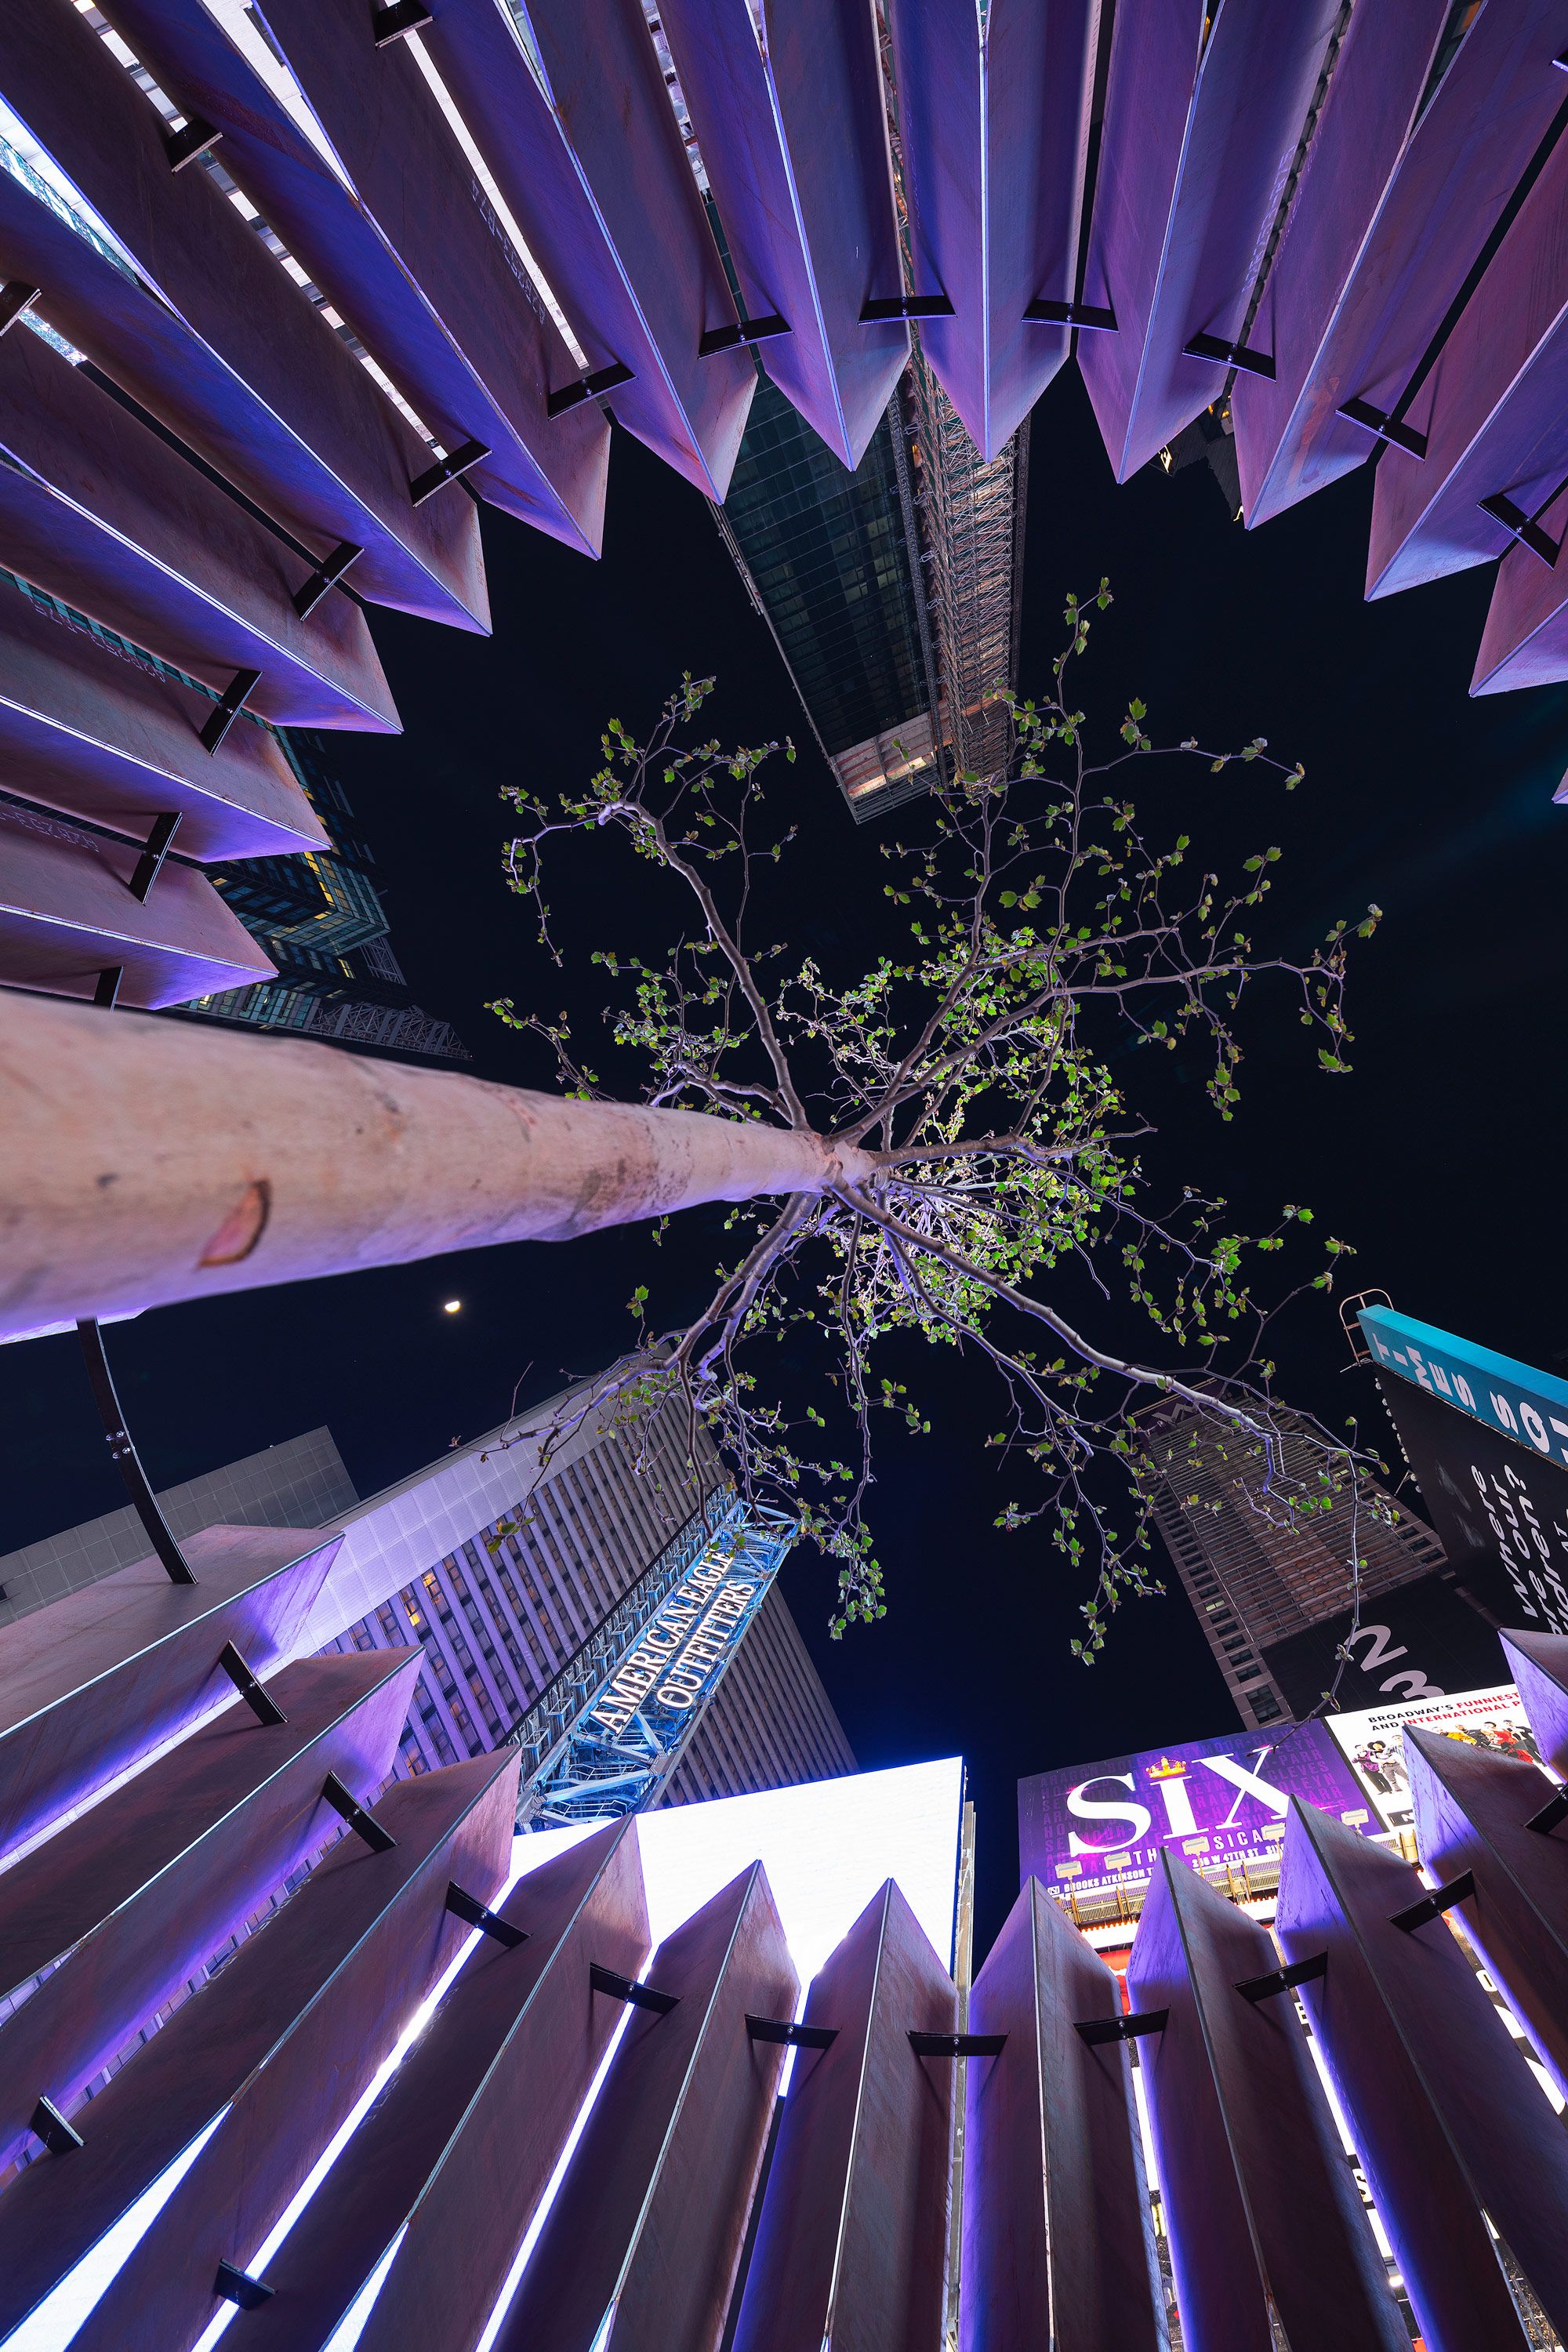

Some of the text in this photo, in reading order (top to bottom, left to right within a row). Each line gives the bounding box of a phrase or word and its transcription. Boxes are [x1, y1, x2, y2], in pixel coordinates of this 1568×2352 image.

[1372, 1332, 1477, 1412] TIMES
[1471, 1465, 1538, 1619] where
[1490, 1474, 1530, 1559] our
[589, 1548, 734, 1735] AMERICAN EAGLE
[656, 1579, 757, 1711] OUTFITTERS
[1368, 1692, 1520, 1723] BROADWAY'S FUNNIEST
[1372, 1704, 1510, 1731] AND INTERNATIONAL
[1067, 1744, 1291, 1858] SIX
[1064, 1878, 1100, 1893] BROOKS
[1102, 1870, 1145, 1886] ATKINSON
[1223, 1849, 1247, 1862] 47TH
[1247, 1847, 1259, 1857] ST
